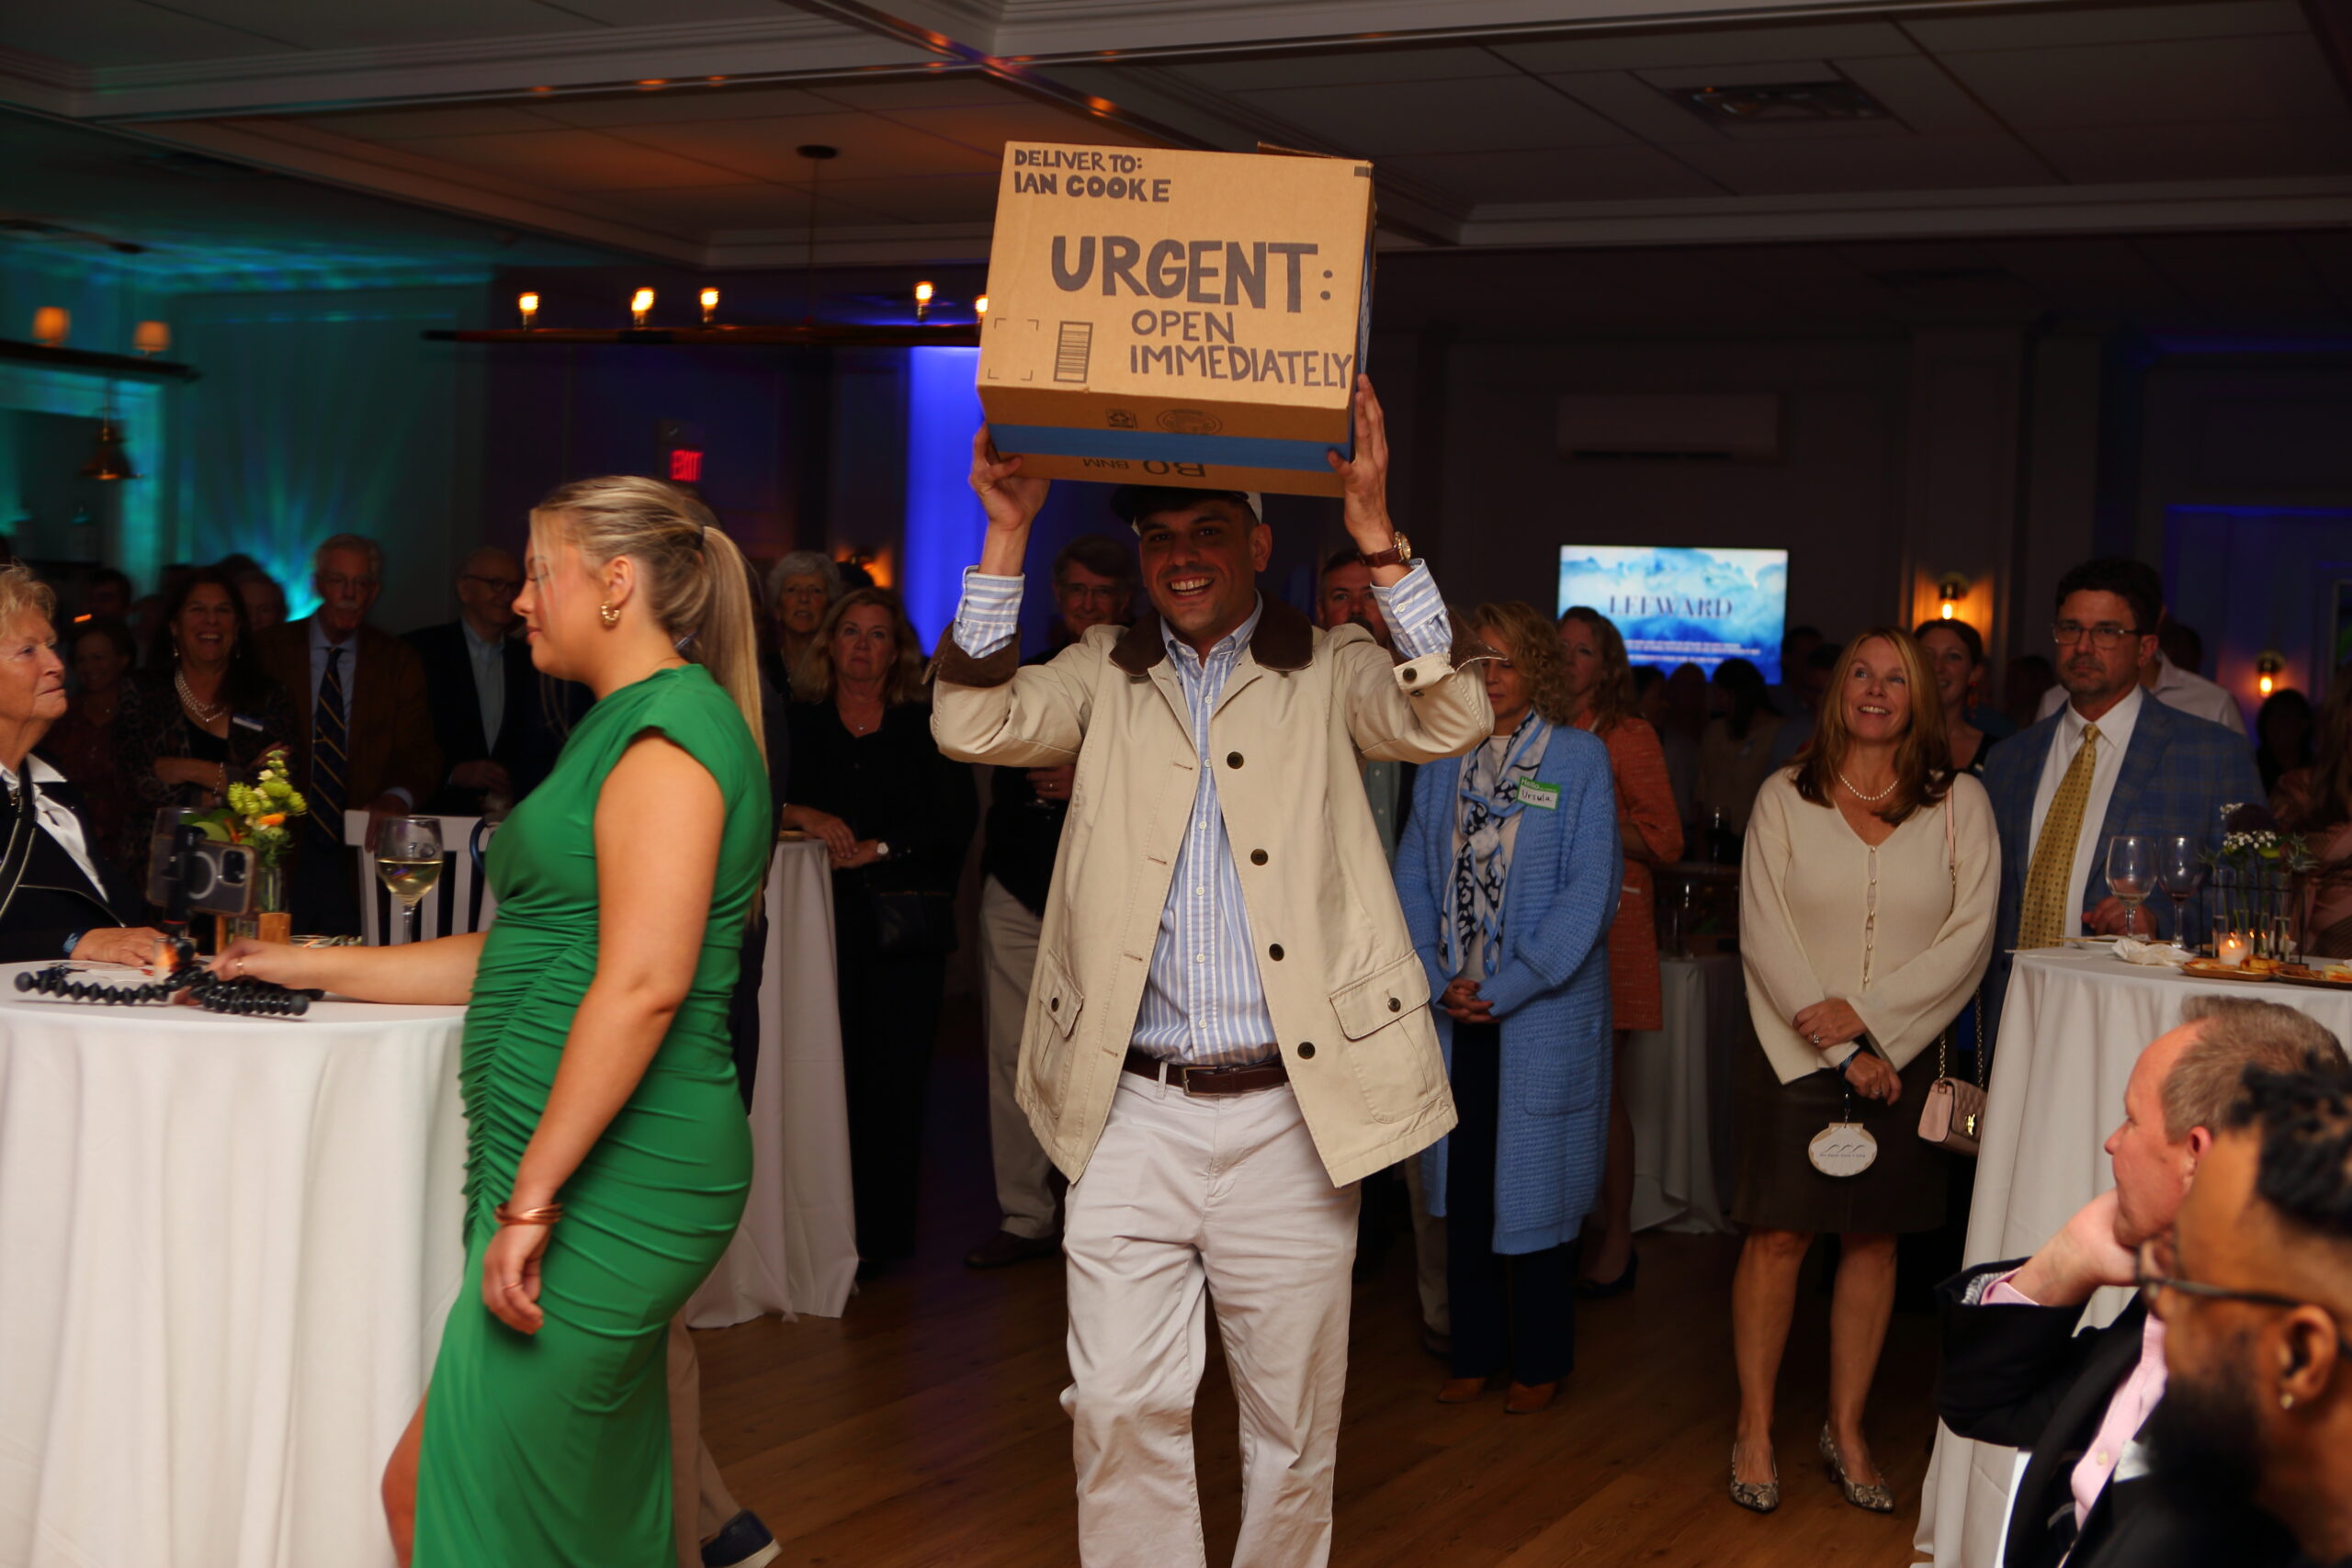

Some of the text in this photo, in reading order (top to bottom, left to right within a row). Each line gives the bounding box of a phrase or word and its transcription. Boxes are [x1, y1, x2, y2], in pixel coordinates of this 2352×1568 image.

[1014, 149, 1143, 173] DELIVER TO:
[1014, 172, 1171, 202] IAN COOKE
[1051, 235, 1334, 313] URGENT:
[1131, 310, 1235, 344] OPEN
[1130, 345, 1353, 389] IMMEDIATELY
